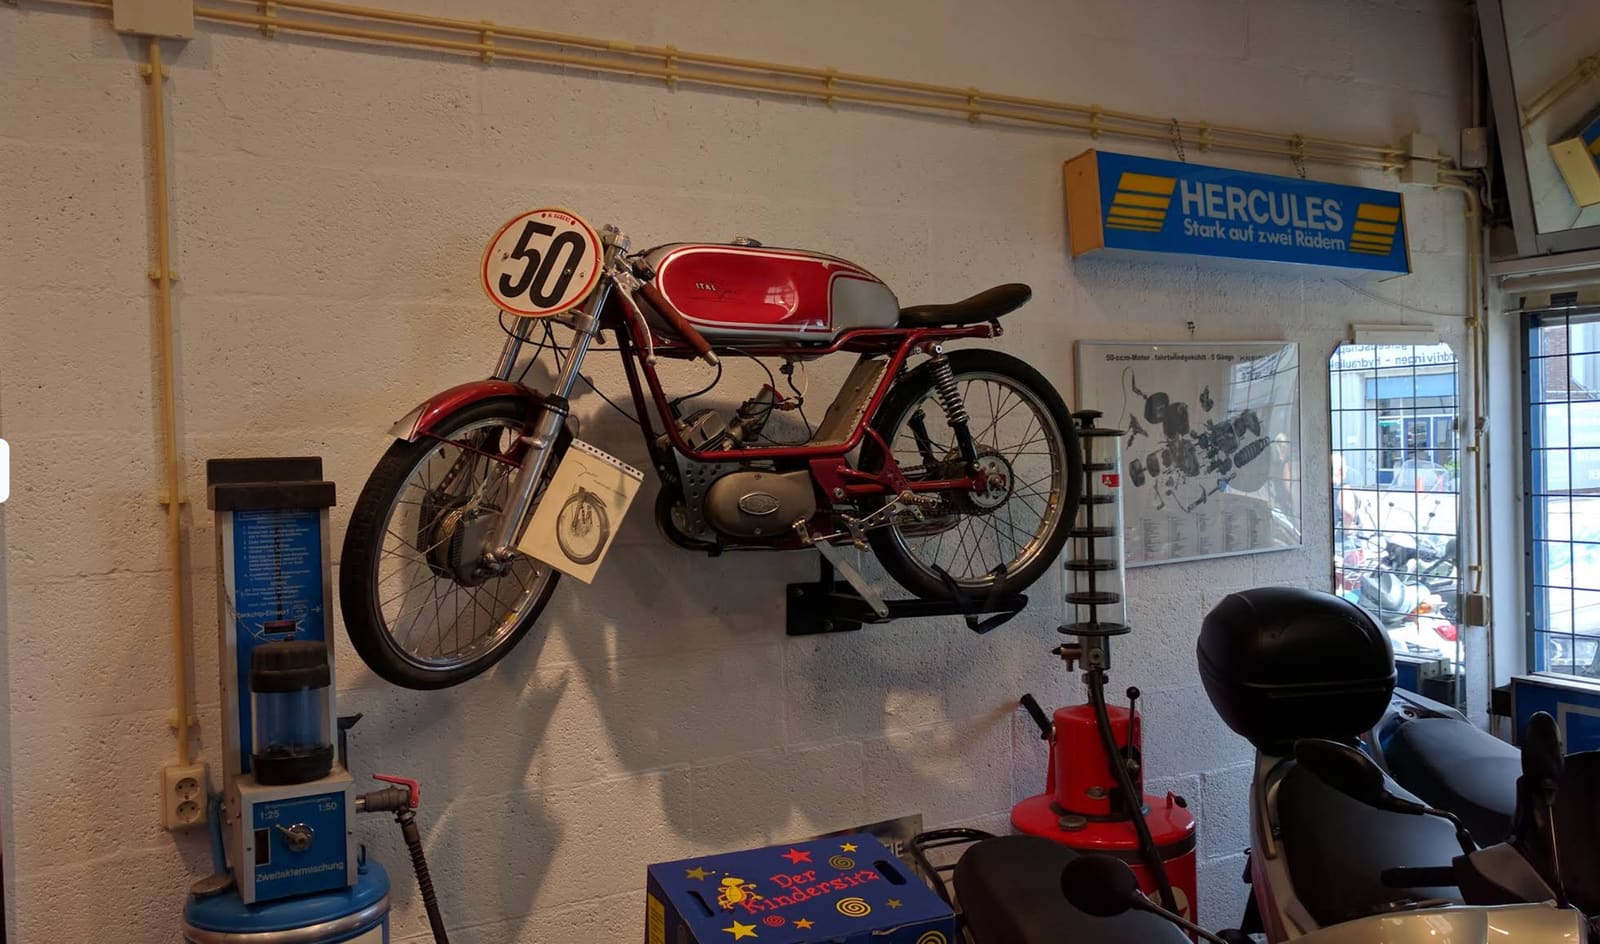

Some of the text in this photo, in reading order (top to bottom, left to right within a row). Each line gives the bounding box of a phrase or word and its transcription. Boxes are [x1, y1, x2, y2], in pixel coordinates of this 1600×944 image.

[1180, 178, 1343, 232] HERCULES
[1184, 219, 1345, 250] Stark auf zwei Rädern
[499, 220, 586, 308] 50
[739, 868, 881, 915] Kindersitz
[769, 869, 818, 889] Der
